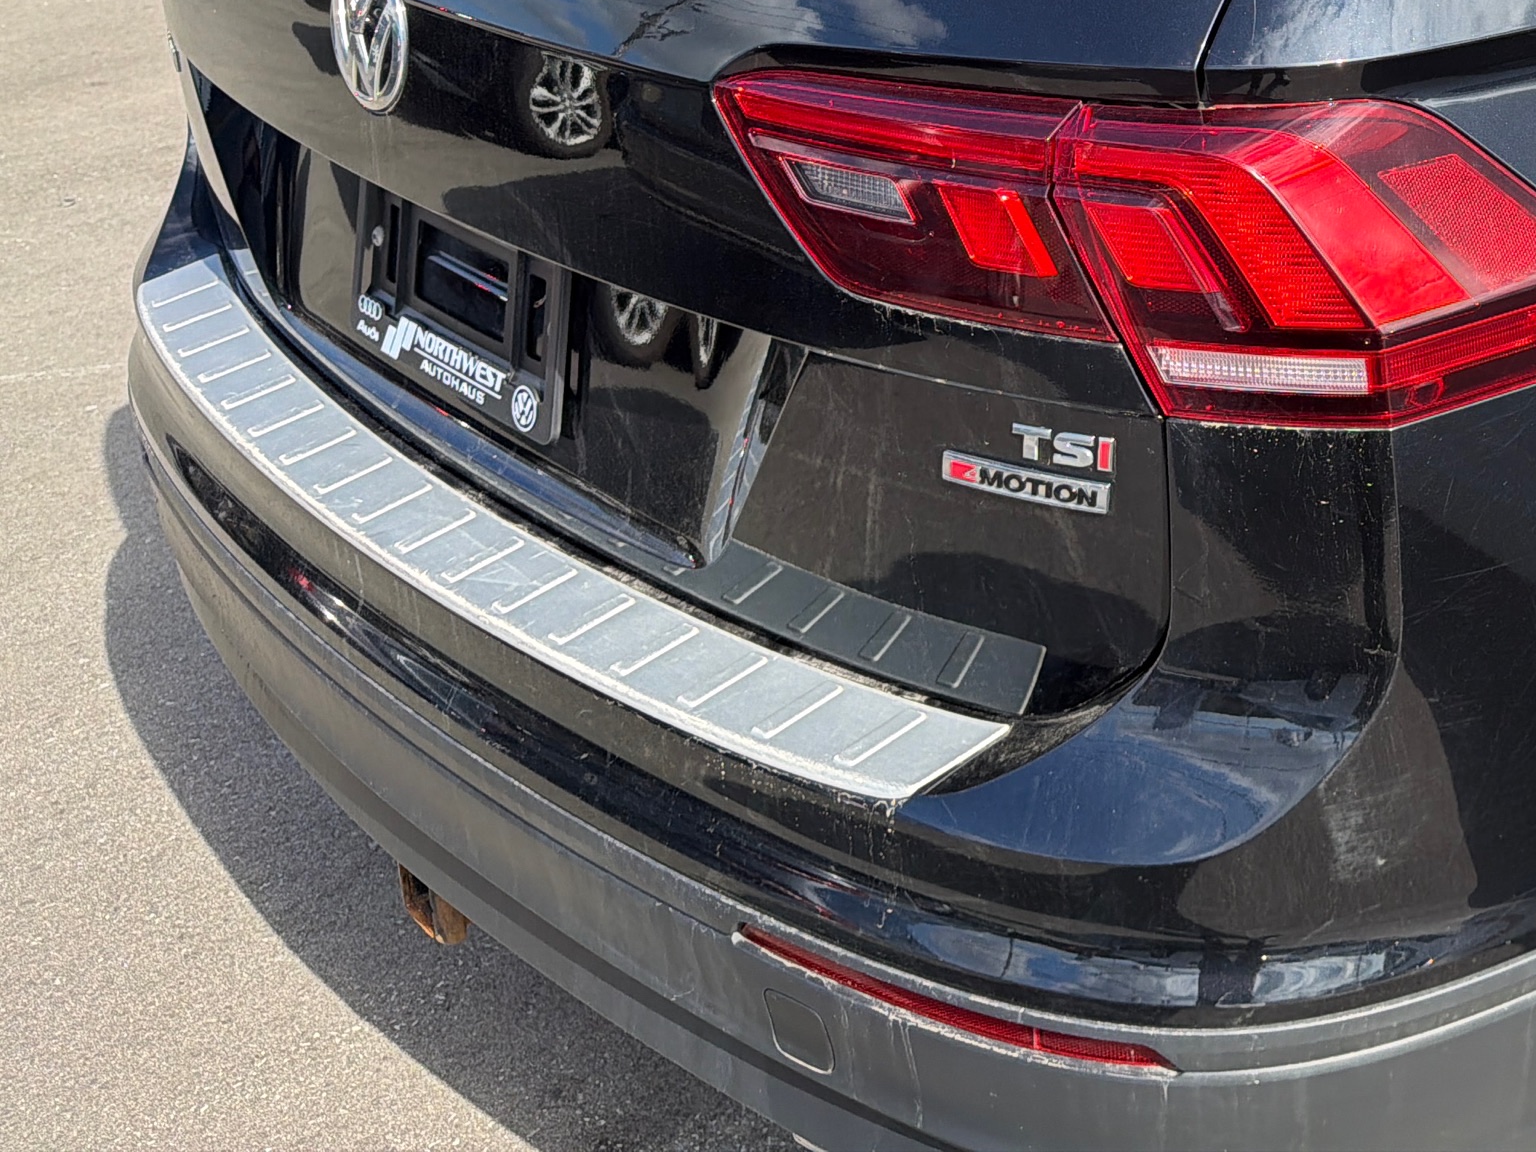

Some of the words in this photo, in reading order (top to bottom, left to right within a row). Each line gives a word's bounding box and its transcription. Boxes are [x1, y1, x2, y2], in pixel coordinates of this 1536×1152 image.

[414, 325, 507, 393] NORTHWEST
[419, 358, 486, 406] AUTOHAUS
[1012, 422, 1115, 472] TSI
